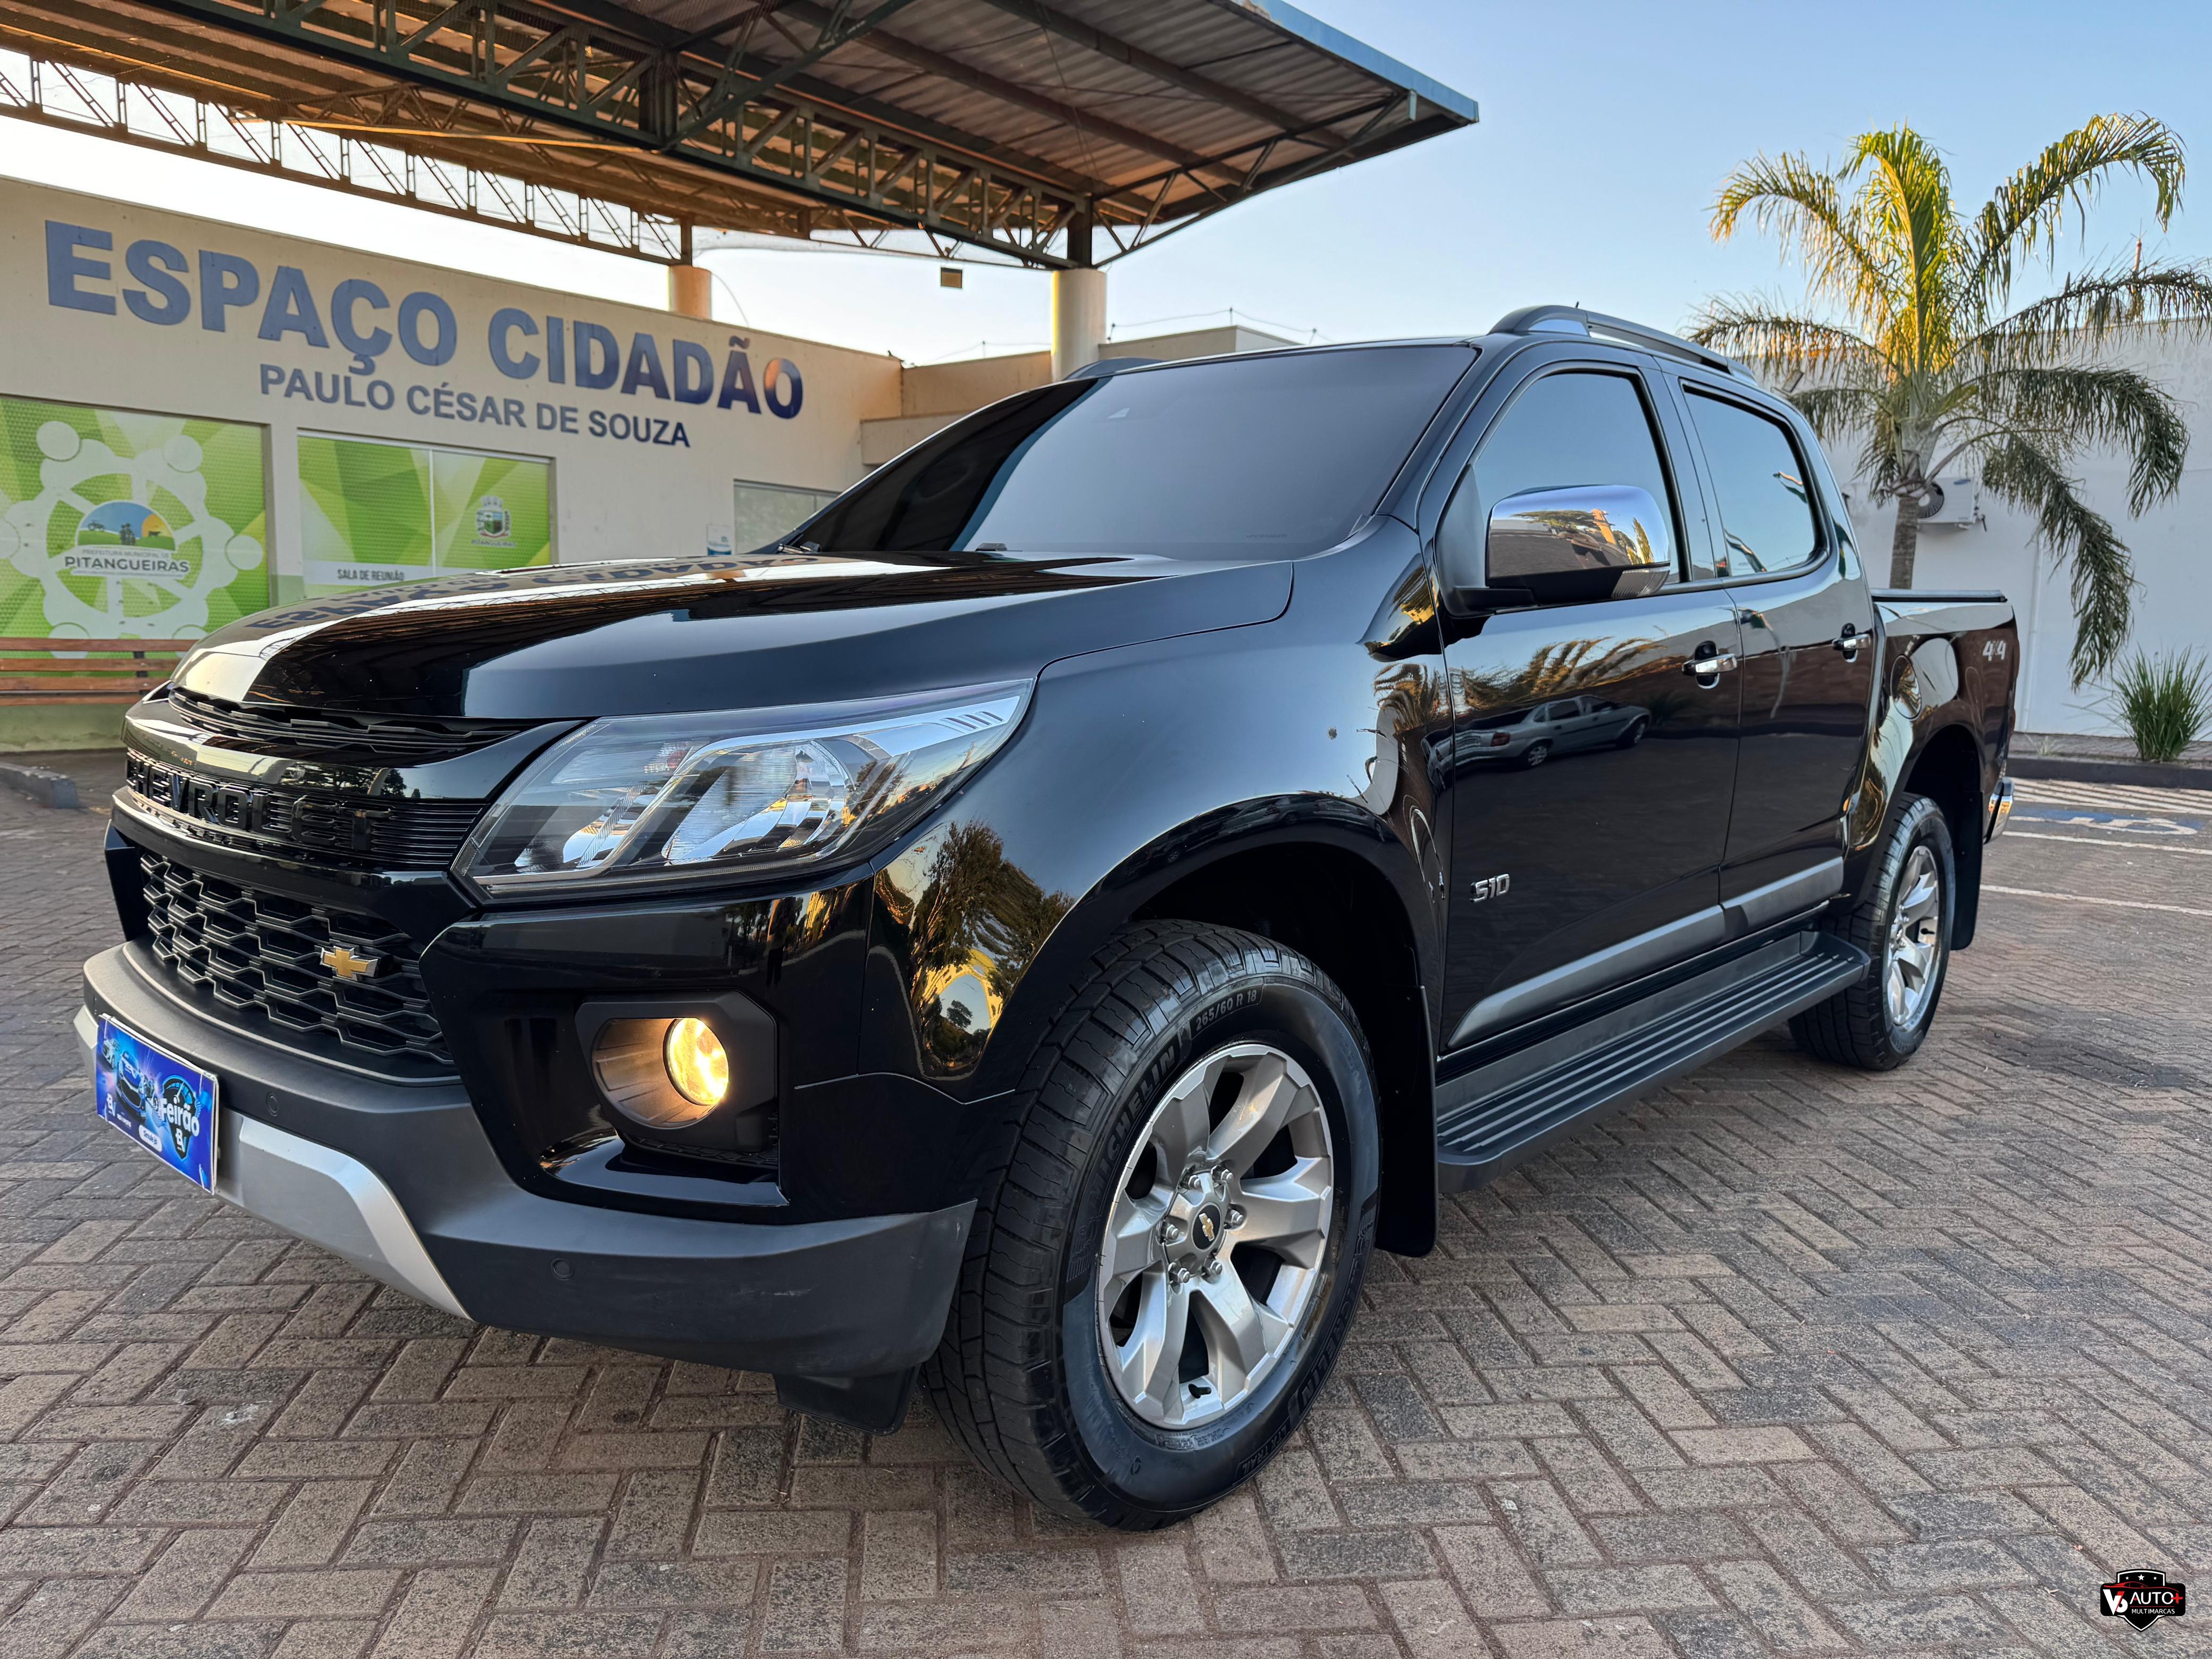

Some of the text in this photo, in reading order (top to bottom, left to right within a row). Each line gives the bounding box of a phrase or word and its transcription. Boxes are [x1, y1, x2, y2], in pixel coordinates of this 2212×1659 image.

[45, 219, 803, 420] ESPAÇO CIDADÃO
[259, 364, 691, 448] PAULO CÉSAR DE SOUZA
[64, 556, 190, 573] PITANGUEIRAS
[337, 568, 404, 581] SALA DE REUNIÃO
[1469, 873, 1510, 903] S10
[1195, 989, 1257, 1032] 265/60 R 18
